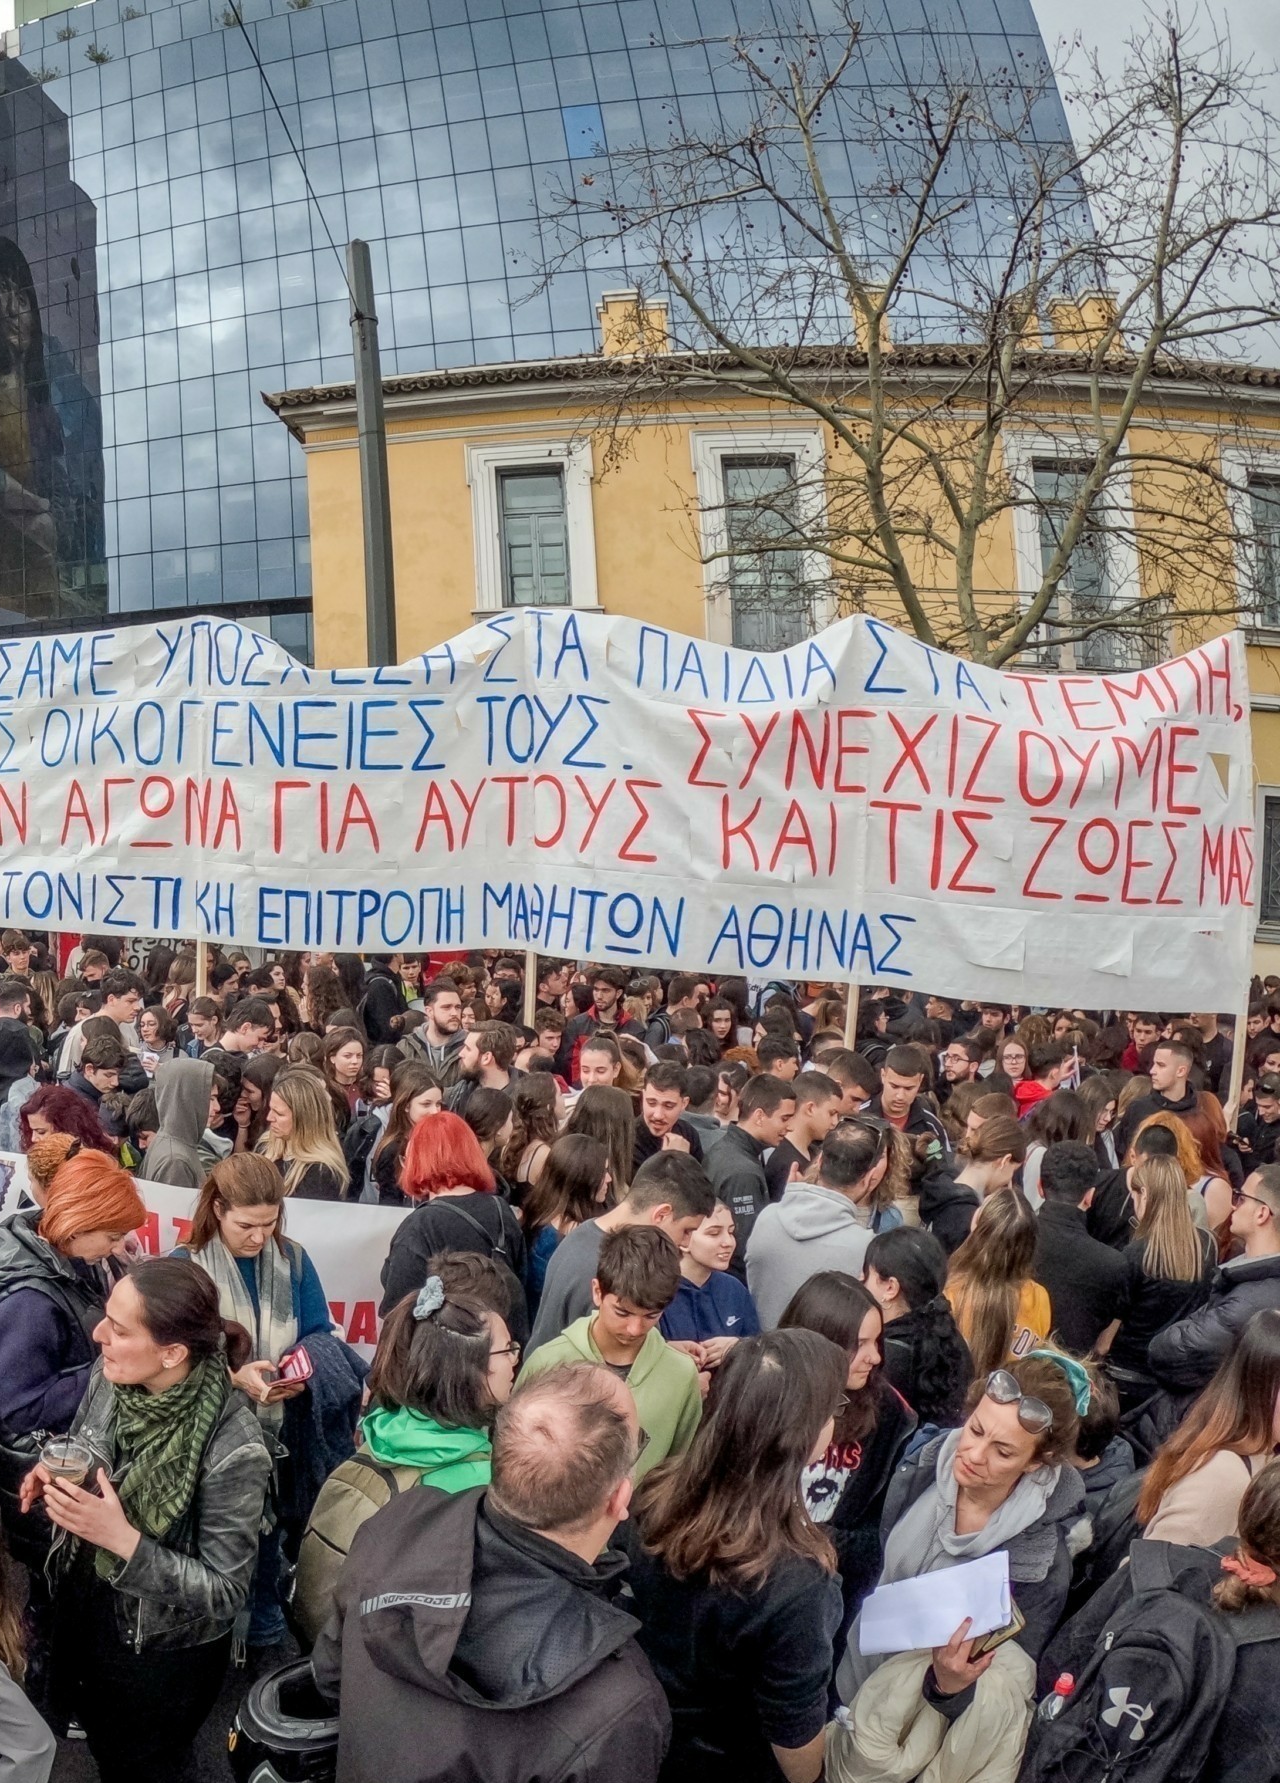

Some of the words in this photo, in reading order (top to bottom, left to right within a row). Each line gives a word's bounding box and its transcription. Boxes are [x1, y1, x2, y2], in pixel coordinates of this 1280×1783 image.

[484, 609, 590, 683] ΣΤΑ
[637, 626, 836, 703] ΠΑΙΔΙΑ
[864, 619, 990, 712] ΣΤΑ
[1004, 637, 1243, 731] ΤΕΜΠΗ,
[41, 699, 449, 771] ΟΙΚΟΓΕΝΕΙΕΣ
[477, 693, 633, 770] ΤΟΥΣ.
[687, 708, 1201, 815] ΣΥΝΕΧΙΖΟΥΜΕ
[61, 775, 241, 852] ΑΓΩΝΑ
[274, 781, 380, 854] ΓΙΑ
[415, 774, 662, 862] ΑΥΤΟΥΣ
[721, 793, 836, 877] ΚΑΙ
[869, 800, 996, 894] ΤΙΣ
[1022, 816, 1186, 906] ΖΩΕΣ
[1197, 822, 1255, 908] ΜΑΣ
[258, 884, 464, 947] ΕΠΙΤΡΟΠΗ
[481, 880, 685, 958] ΜΑΘΗΤΩΝ
[708, 902, 916, 977] ΑΘΗΝΑΣ
[382, 1594, 453, 1606] NORDCODE
